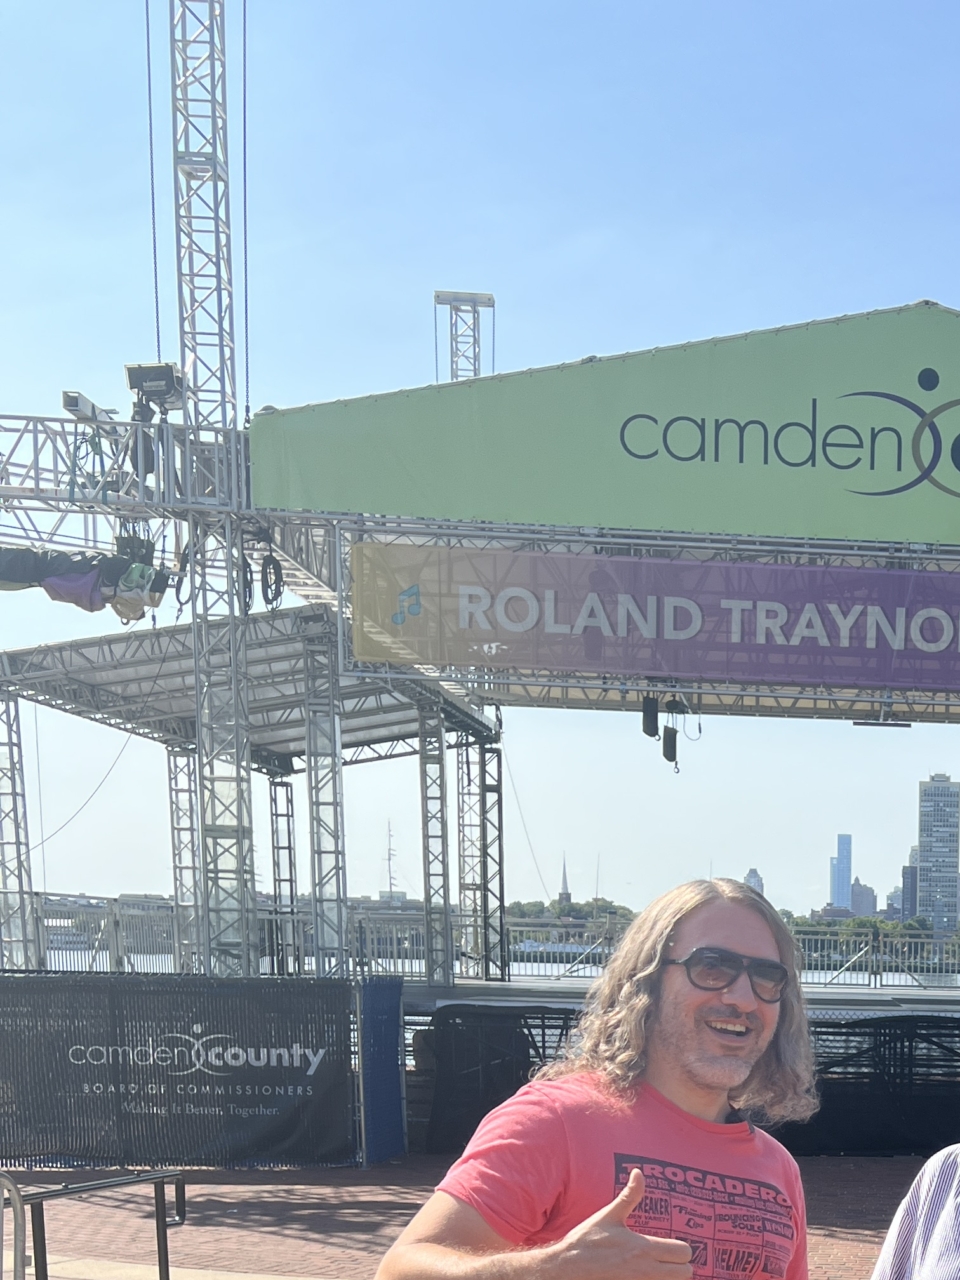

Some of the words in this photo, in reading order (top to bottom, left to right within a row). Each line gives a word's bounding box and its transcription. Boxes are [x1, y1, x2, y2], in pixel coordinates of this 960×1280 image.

[619, 397, 903, 472] camden
[457, 585, 703, 641] ROLAND
[68, 1037, 187, 1065] camden
[207, 1043, 326, 1075] county
[83, 1083, 139, 1094] BOARD
[147, 1084, 167, 1094] OF
[176, 1084, 314, 1096] COMMISSIONERS
[122, 1101, 168, 1116] Making
[172, 1103, 182, 1114] It
[186, 1102, 224, 1116] Better,
[227, 1103, 280, 1118] Together.
[622, 1163, 793, 1207] TROCADERO
[714, 1247, 761, 1274] HELMET
